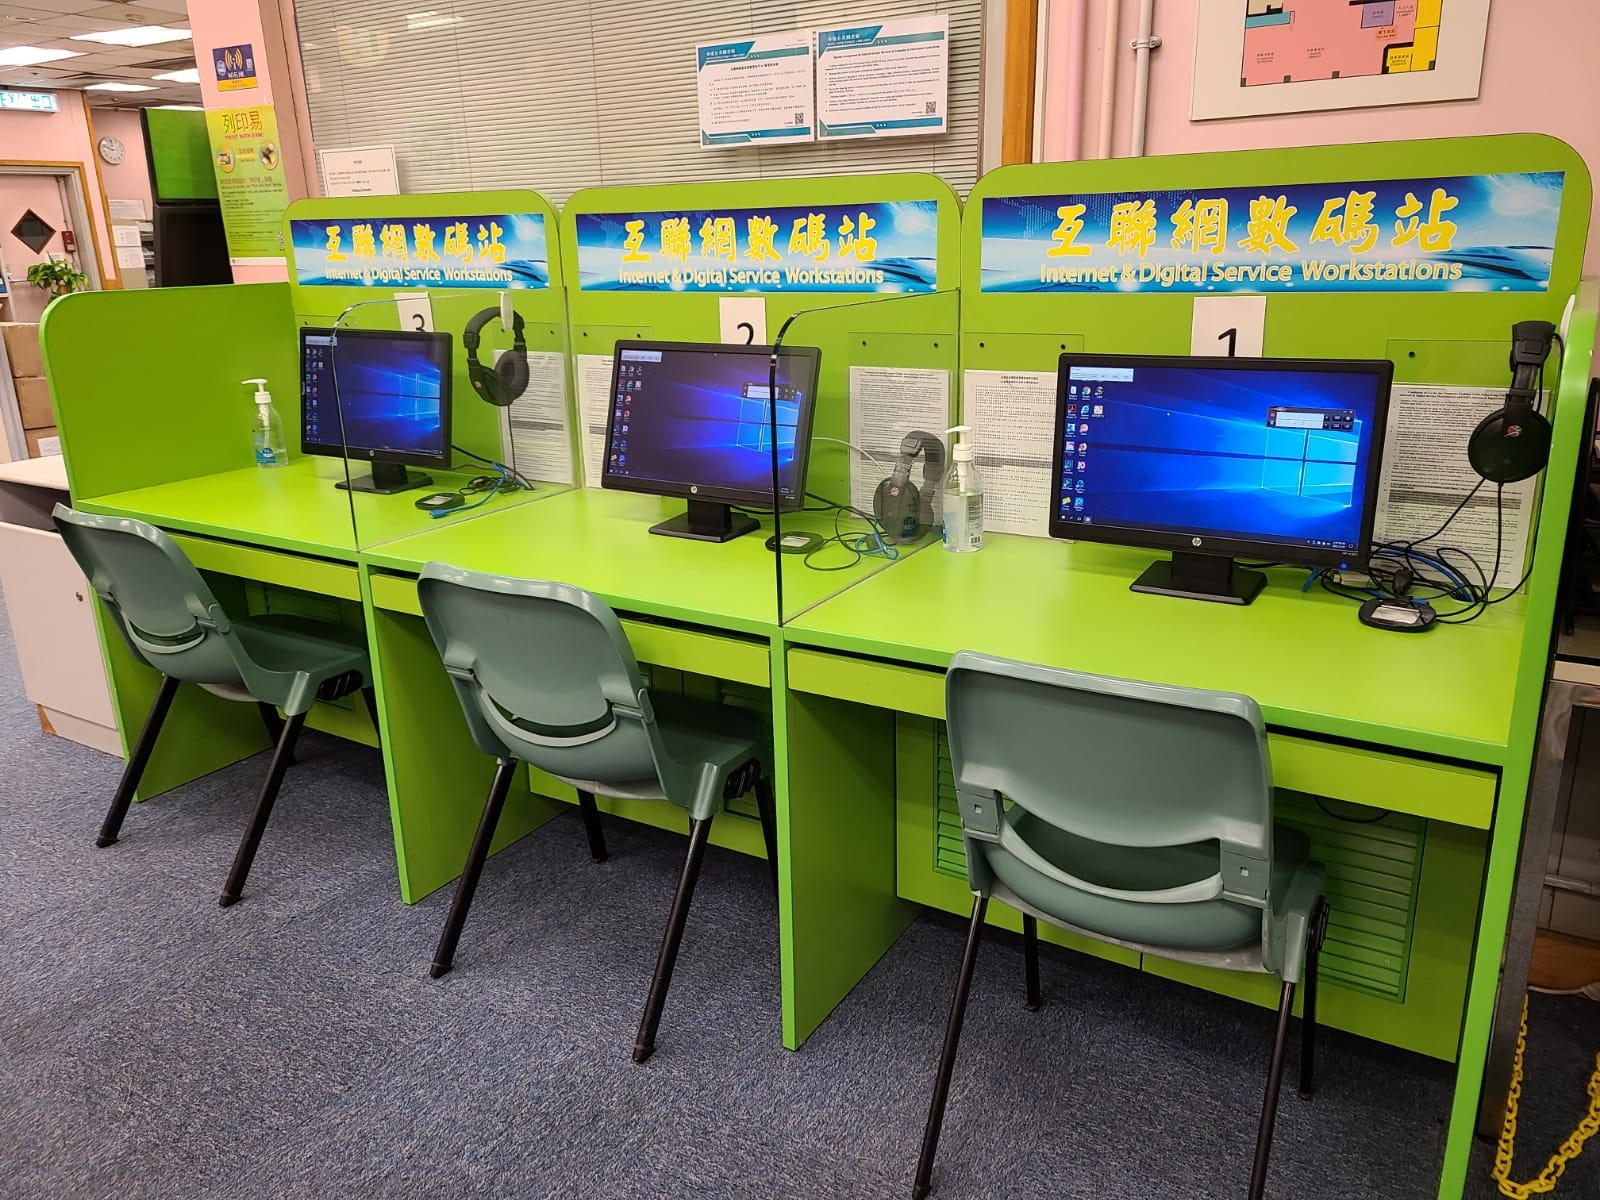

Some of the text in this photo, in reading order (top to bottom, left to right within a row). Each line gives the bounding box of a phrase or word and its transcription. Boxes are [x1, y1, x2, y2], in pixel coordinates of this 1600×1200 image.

[222, 110, 263, 134] 列印易
[1047, 188, 1460, 259] 互聯網數碼站
[325, 221, 506, 263] 互聯網數碼站
[621, 212, 878, 264] 互聯網數碼站
[325, 266, 363, 280] Internet
[371, 267, 403, 283] Digital
[404, 267, 441, 281] Service
[443, 267, 513, 282] Workstations
[618, 267, 884, 287] Internet & Digital Service Workstations
[1040, 260, 1464, 287] Internet & Digital Service Workstations
[1217, 327, 1237, 357] 1
